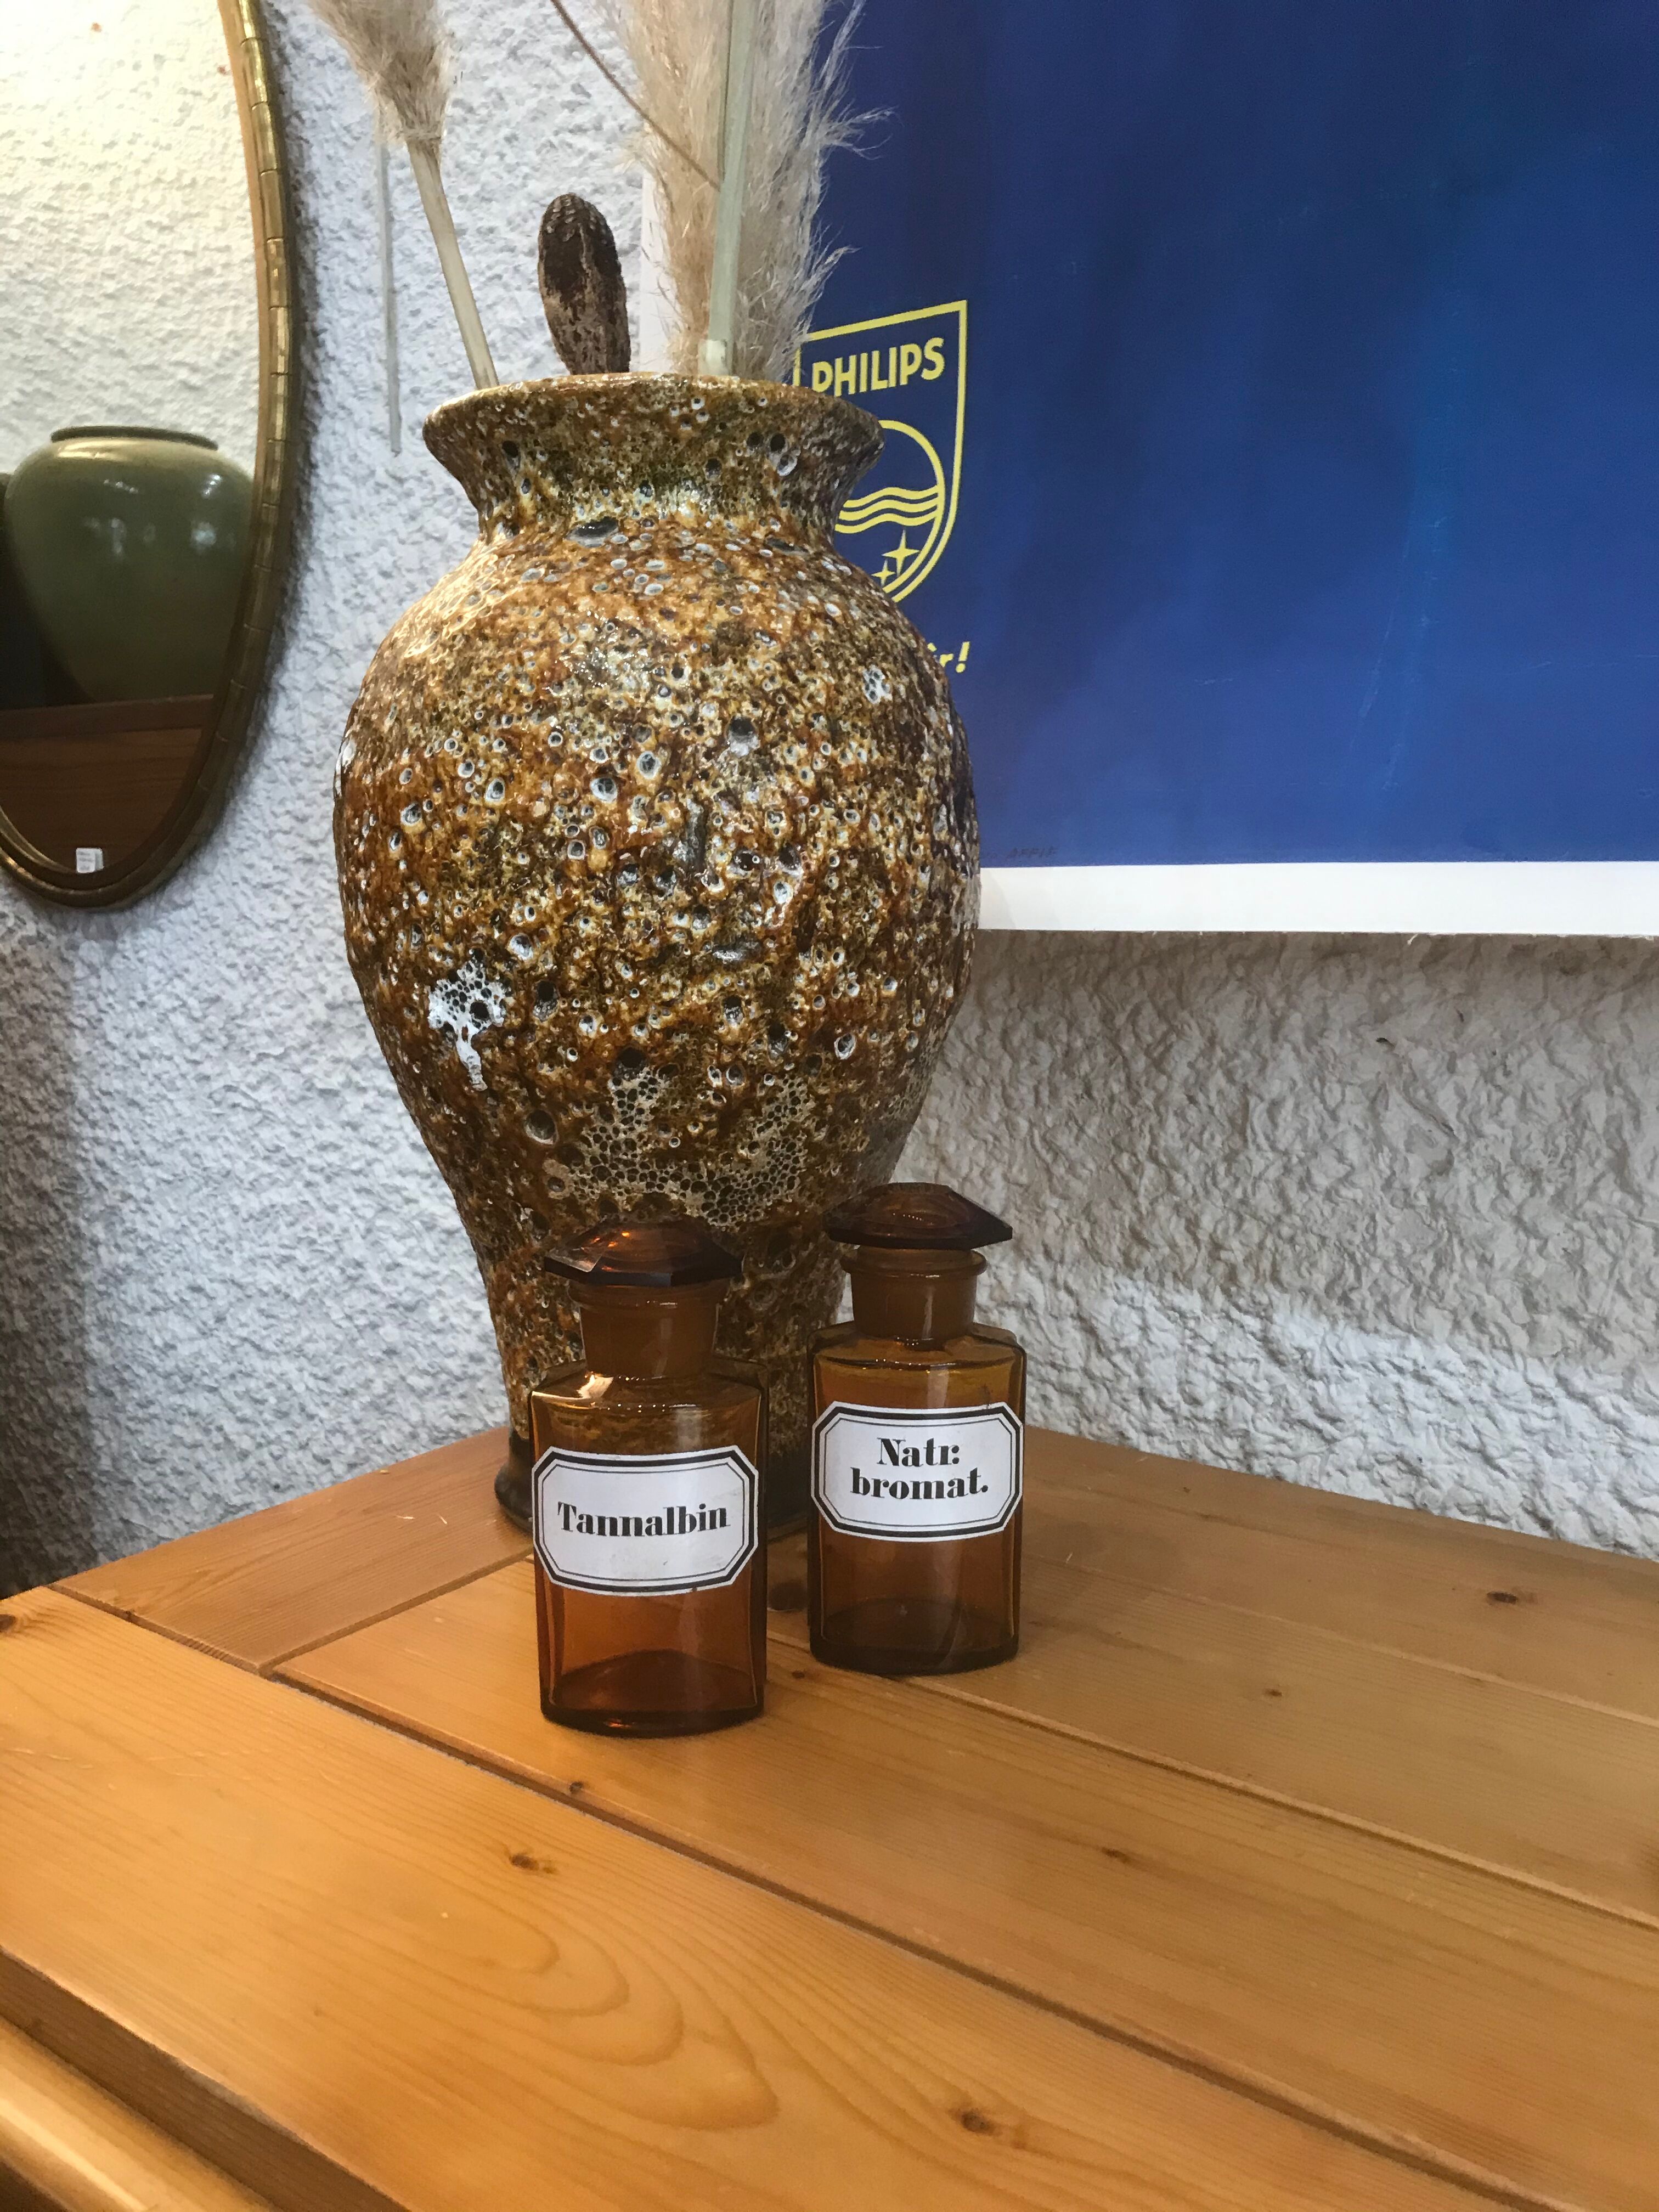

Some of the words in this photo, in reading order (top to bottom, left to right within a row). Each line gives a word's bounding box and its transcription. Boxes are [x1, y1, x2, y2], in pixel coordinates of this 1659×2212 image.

[812, 337, 945, 397] PHILIPS
[850, 1467, 989, 1499] bromat.
[557, 1501, 731, 1537] Tannalbin
